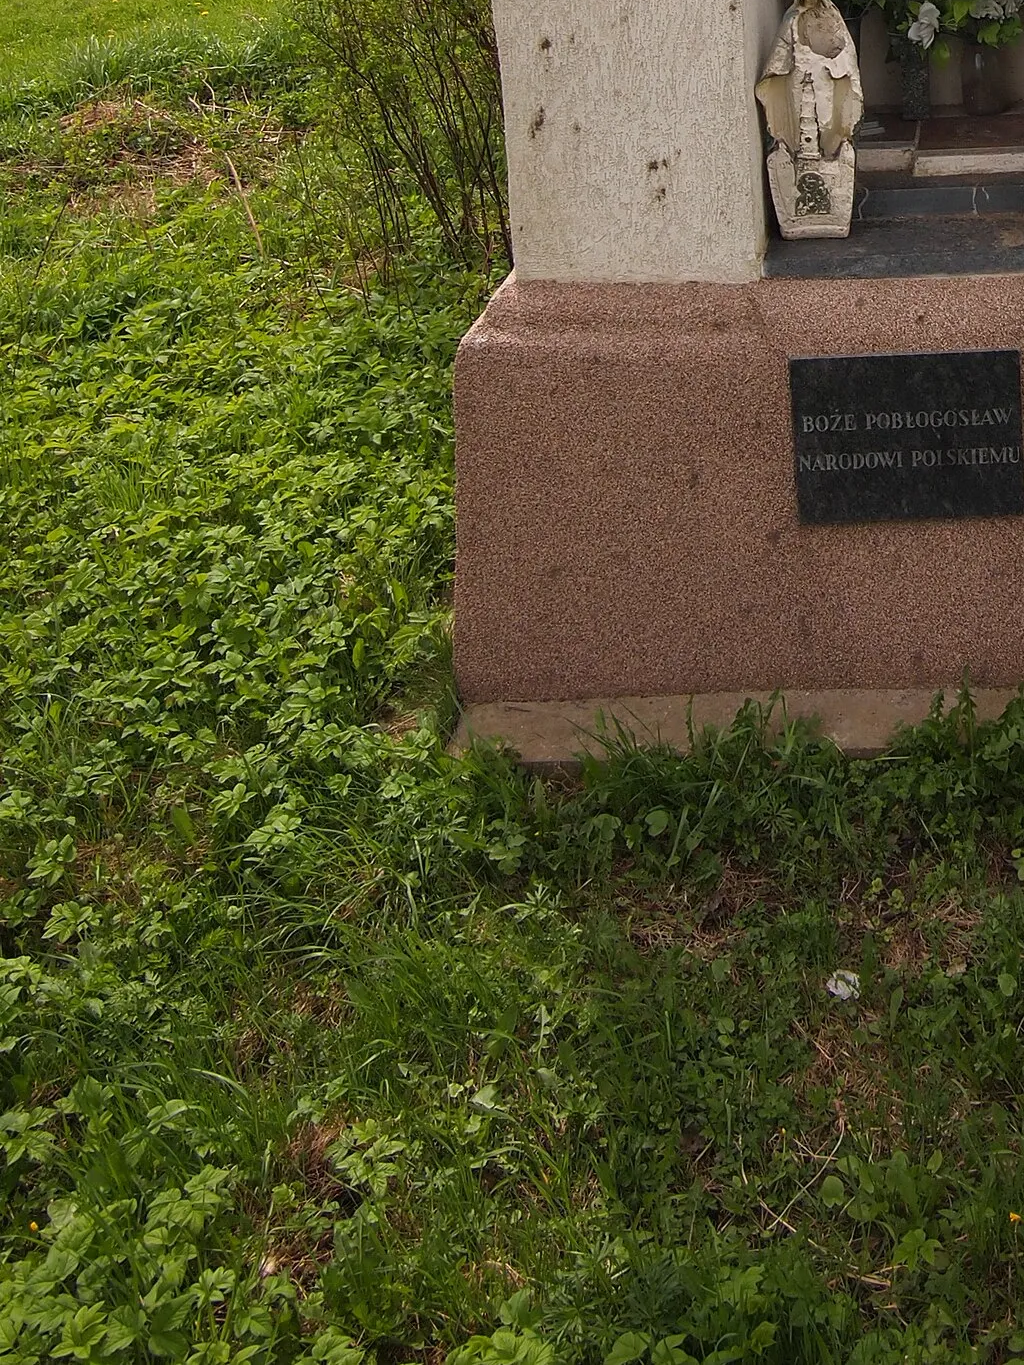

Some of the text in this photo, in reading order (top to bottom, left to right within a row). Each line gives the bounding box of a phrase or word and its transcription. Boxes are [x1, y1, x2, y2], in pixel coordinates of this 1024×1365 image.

[803, 408, 1013, 433] BOŻE POBŁOGOSŁAW
[799, 446, 1021, 472] NARODOWI POLSKIEMU
